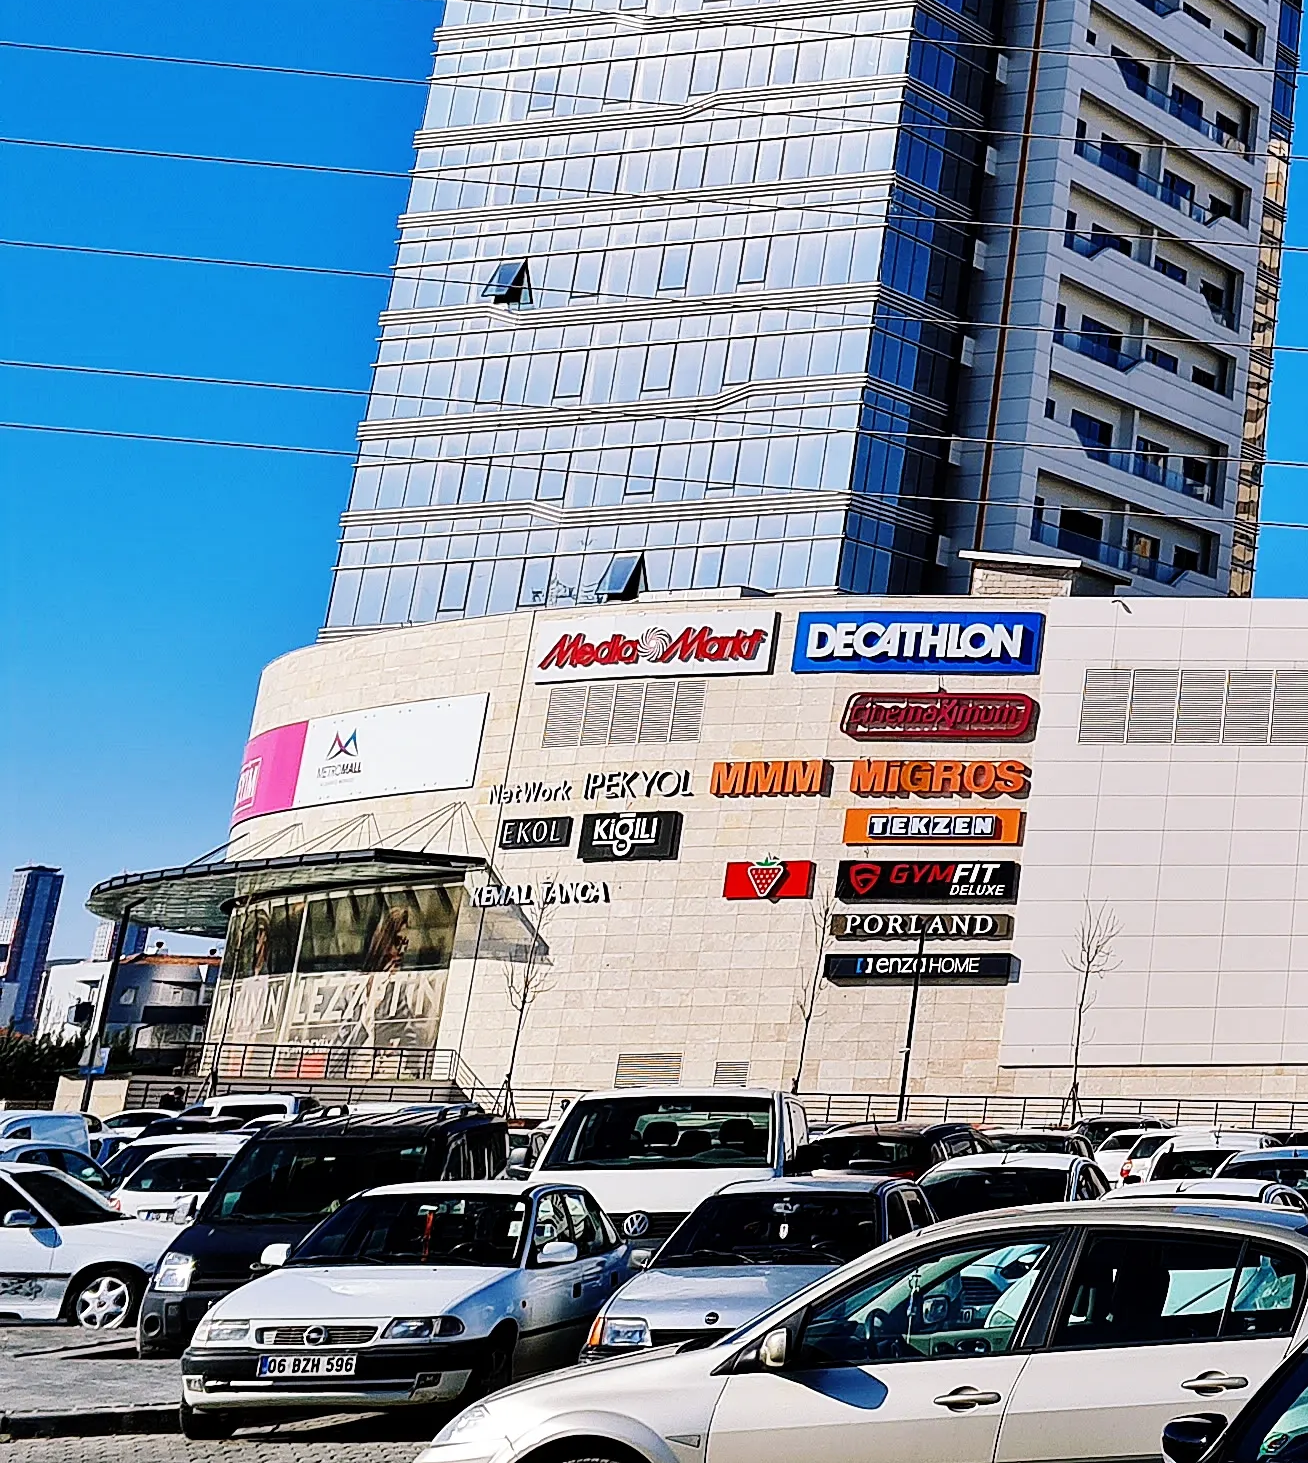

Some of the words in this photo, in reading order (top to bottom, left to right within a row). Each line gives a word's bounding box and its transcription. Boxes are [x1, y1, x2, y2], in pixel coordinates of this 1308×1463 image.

[537, 632, 640, 670] Media
[658, 625, 768, 664] Markt
[805, 621, 1024, 659] DECATHLON
[317, 761, 362, 779] METROMALL
[710, 759, 828, 796] MMM
[502, 820, 561, 845] EKOL
[868, 815, 997, 837] TEKZEN
[890, 863, 1001, 884] GYMFIT
[469, 883, 534, 907] KEMAL
[949, 884, 1005, 896] DELUXE
[844, 914, 994, 935] PORLAND
[929, 957, 980, 973] HOME
[267, 1358, 286, 1373] 06
[291, 1357, 320, 1373] BZH
[325, 1356, 354, 1373] 596
